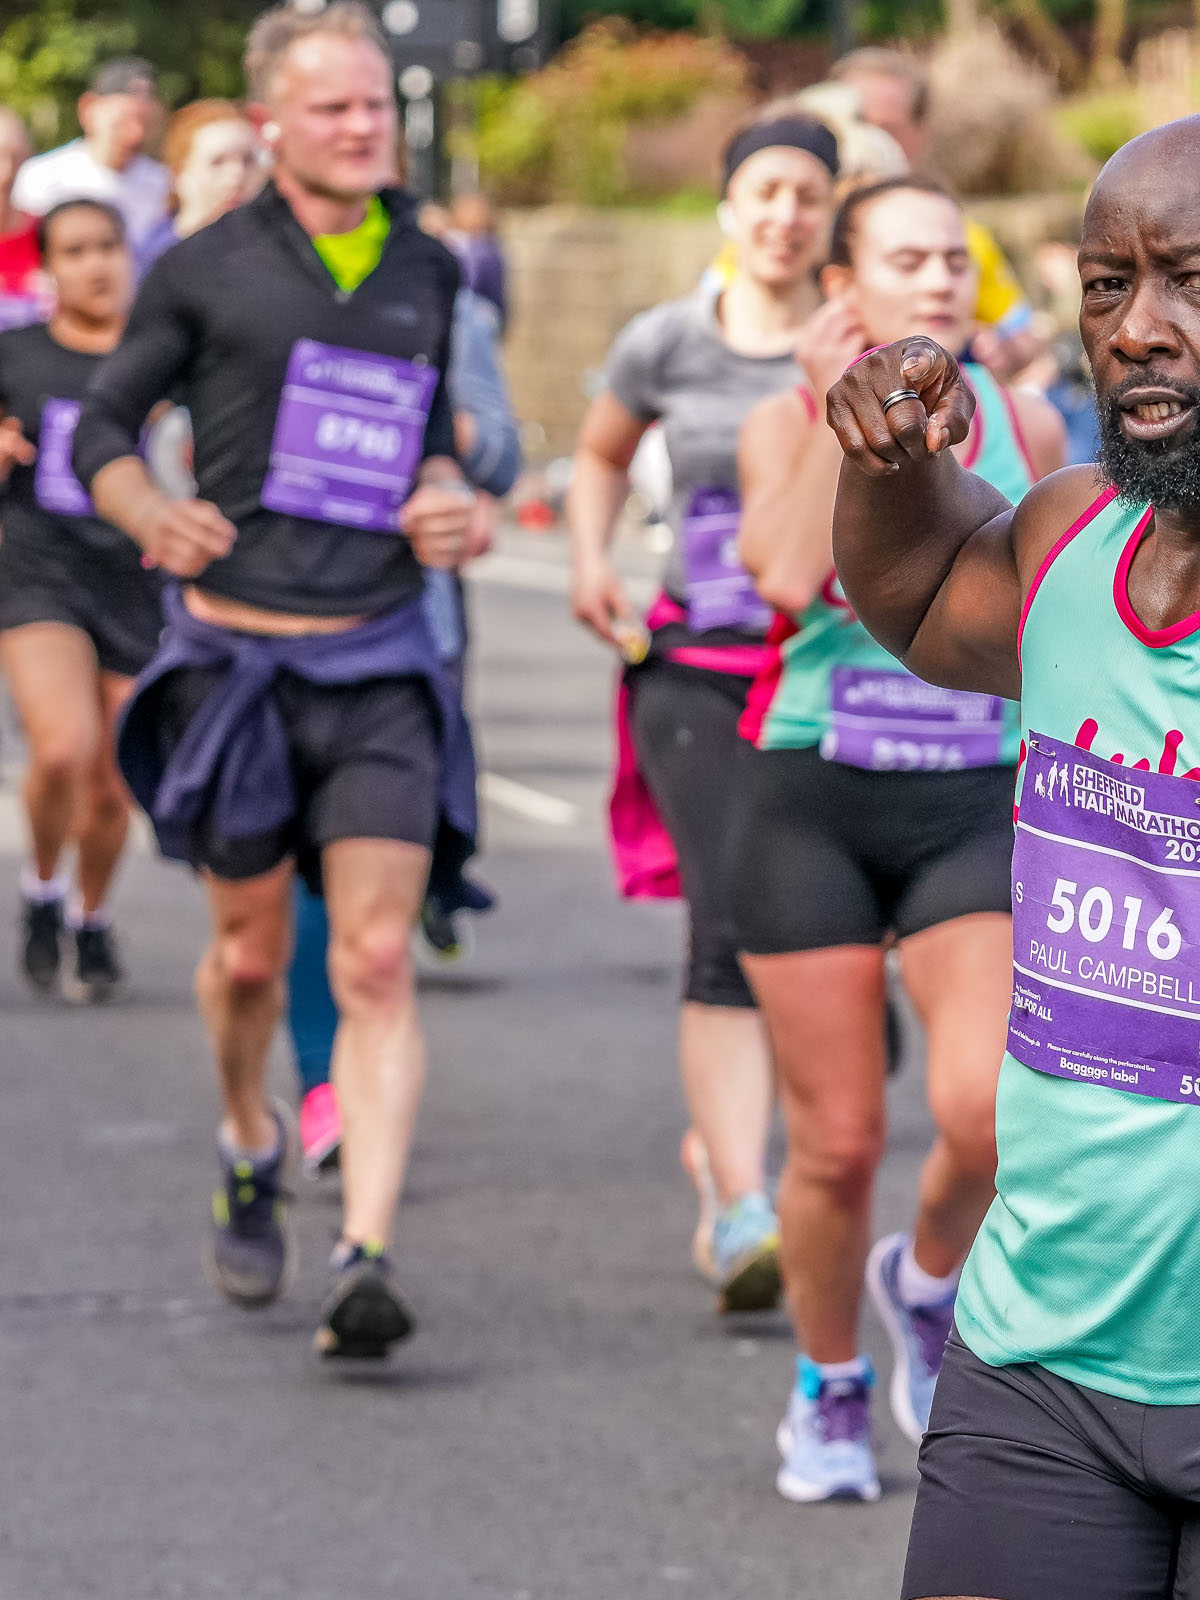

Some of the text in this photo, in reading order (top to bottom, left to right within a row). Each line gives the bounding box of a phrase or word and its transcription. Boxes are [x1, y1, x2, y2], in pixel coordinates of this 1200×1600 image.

[1075, 767, 1142, 806] SHEFFIELD
[1074, 788, 1114, 816] HALF
[1015, 881, 1024, 904] S
[1046, 877, 1182, 961] 5016
[1029, 939, 1072, 975] PAUL
[1037, 1005, 1053, 1022] ALL
[1047, 1042, 1156, 1073] Please tear carefully along the perforated line
[1060, 1056, 1139, 1084] Baggage label
